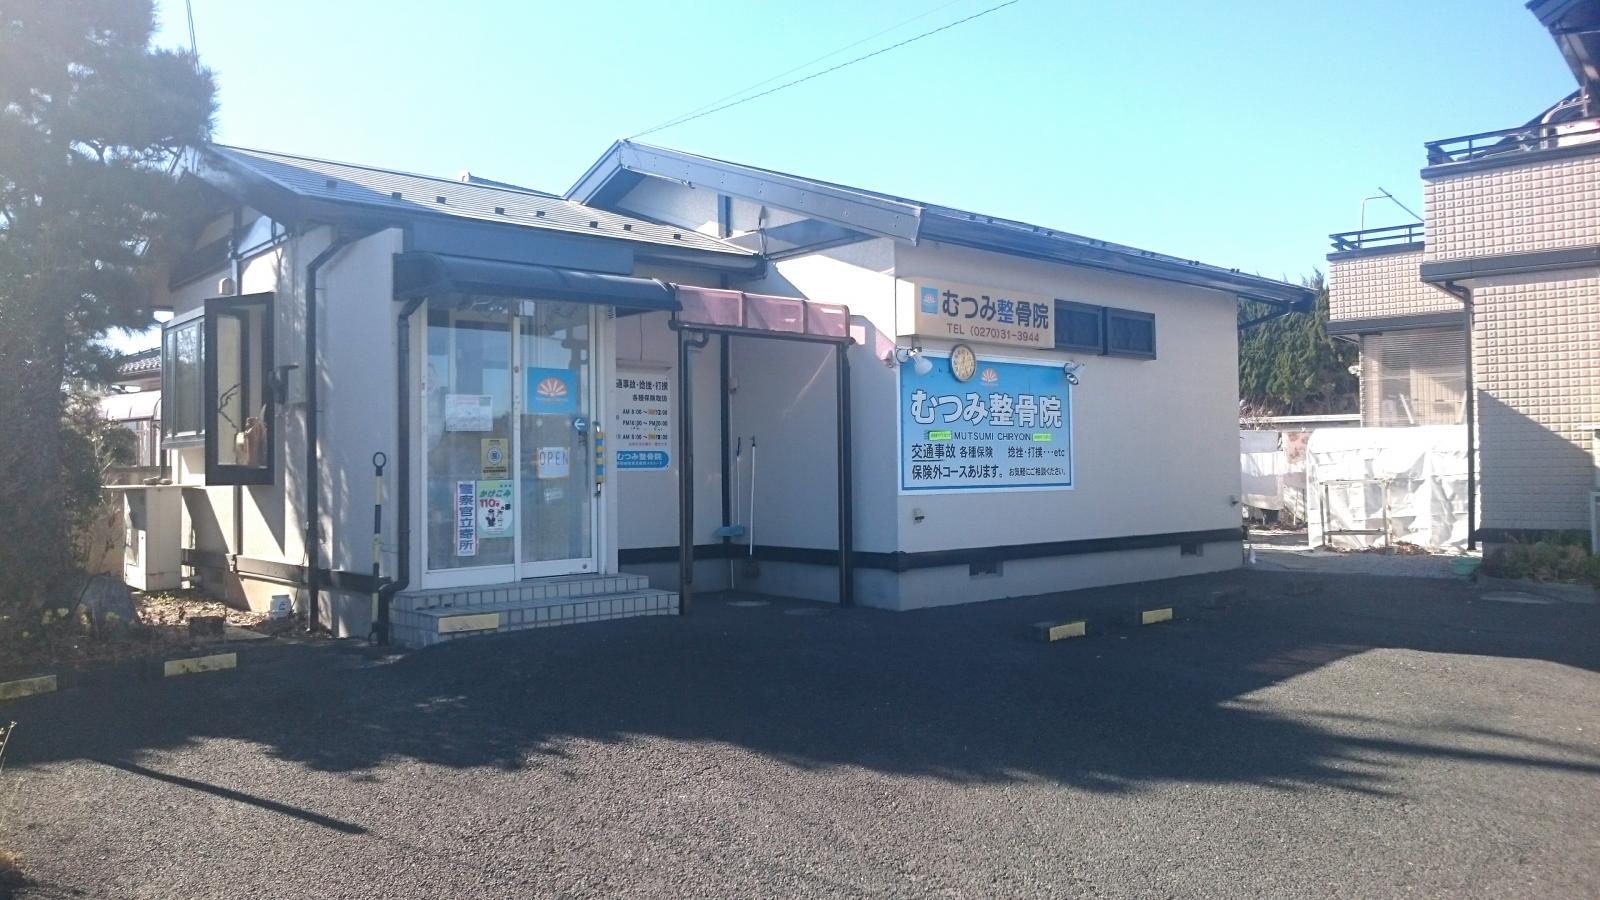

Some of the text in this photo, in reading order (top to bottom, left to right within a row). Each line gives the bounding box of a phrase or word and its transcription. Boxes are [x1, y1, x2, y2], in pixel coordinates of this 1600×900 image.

[942, 289, 1049, 330] むつみ整骨院
[947, 322, 1040, 342] TEL (0270)31-3944
[910, 388, 1063, 428] むつみ整骨院
[954, 431, 994, 441] MUTSUMI
[539, 451, 568, 466] OPEN
[911, 443, 956, 459] 交通事故
[959, 445, 993, 458] 各種保険
[912, 464, 1003, 480] 保険外コースあります。
[459, 483, 473, 551] 警察官立寄所
